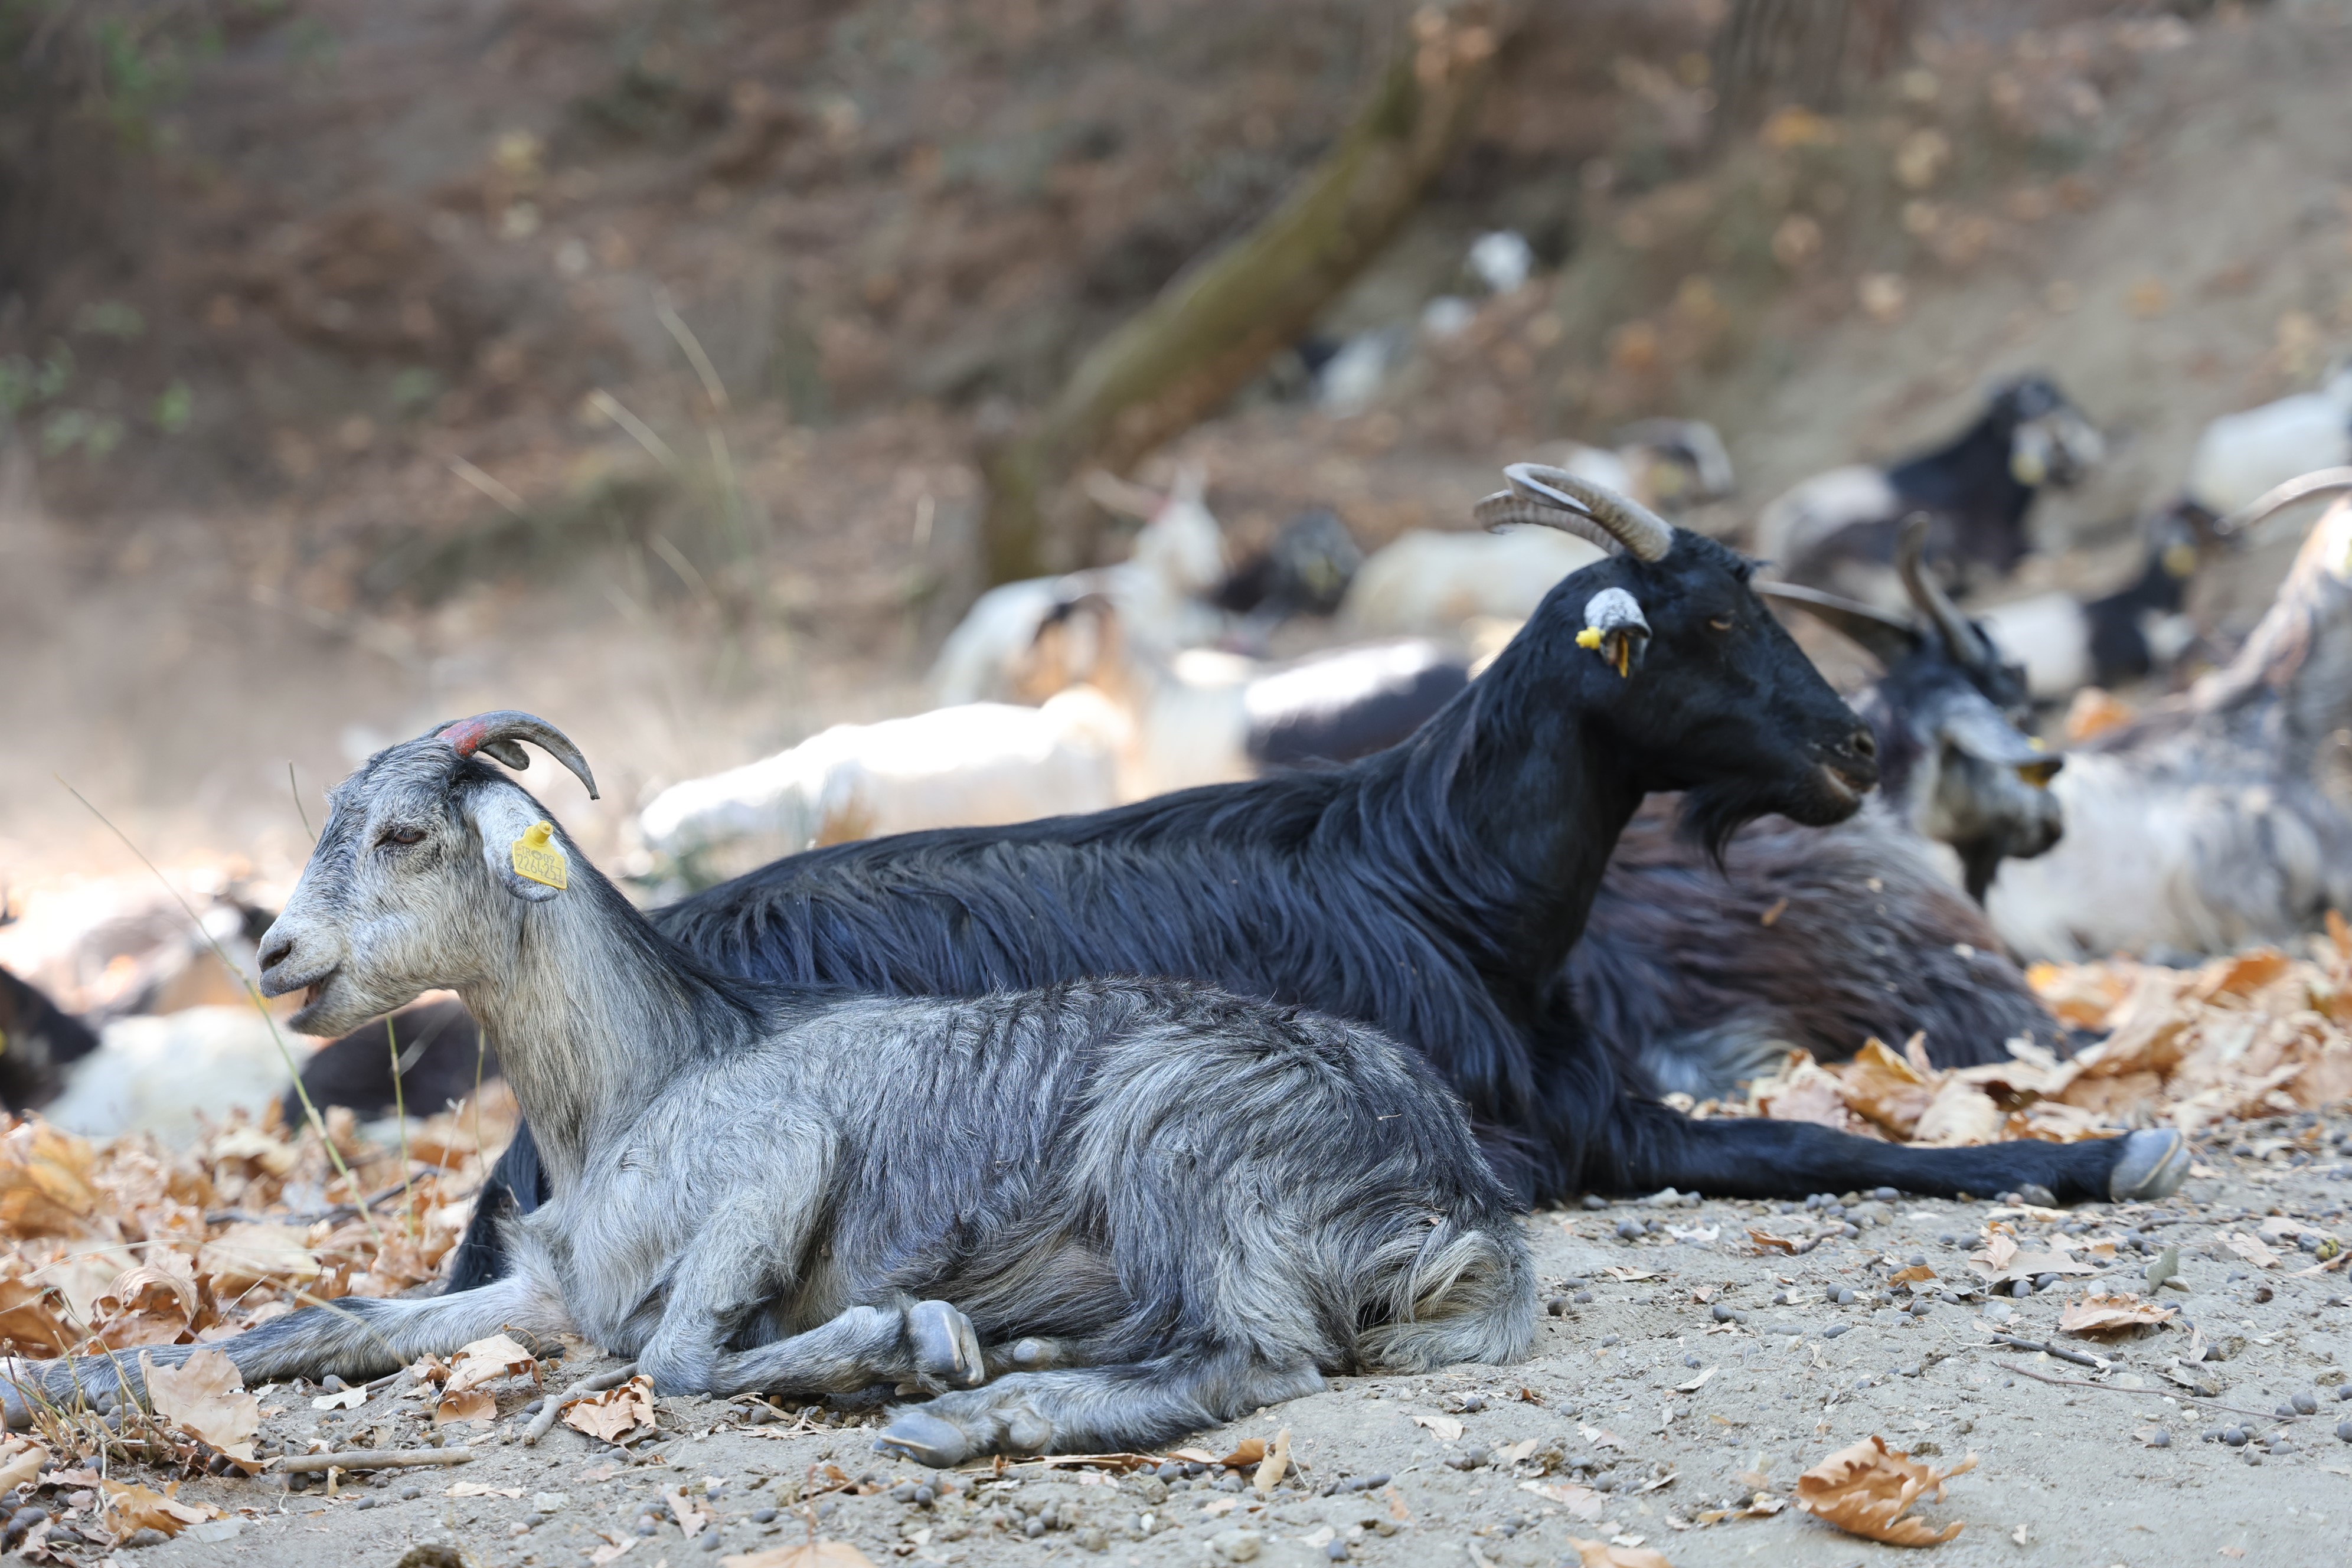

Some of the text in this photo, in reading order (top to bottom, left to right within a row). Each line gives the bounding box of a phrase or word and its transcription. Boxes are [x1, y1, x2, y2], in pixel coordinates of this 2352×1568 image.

[521, 845, 555, 864] TR 09
[517, 854, 562, 881] 2264257
